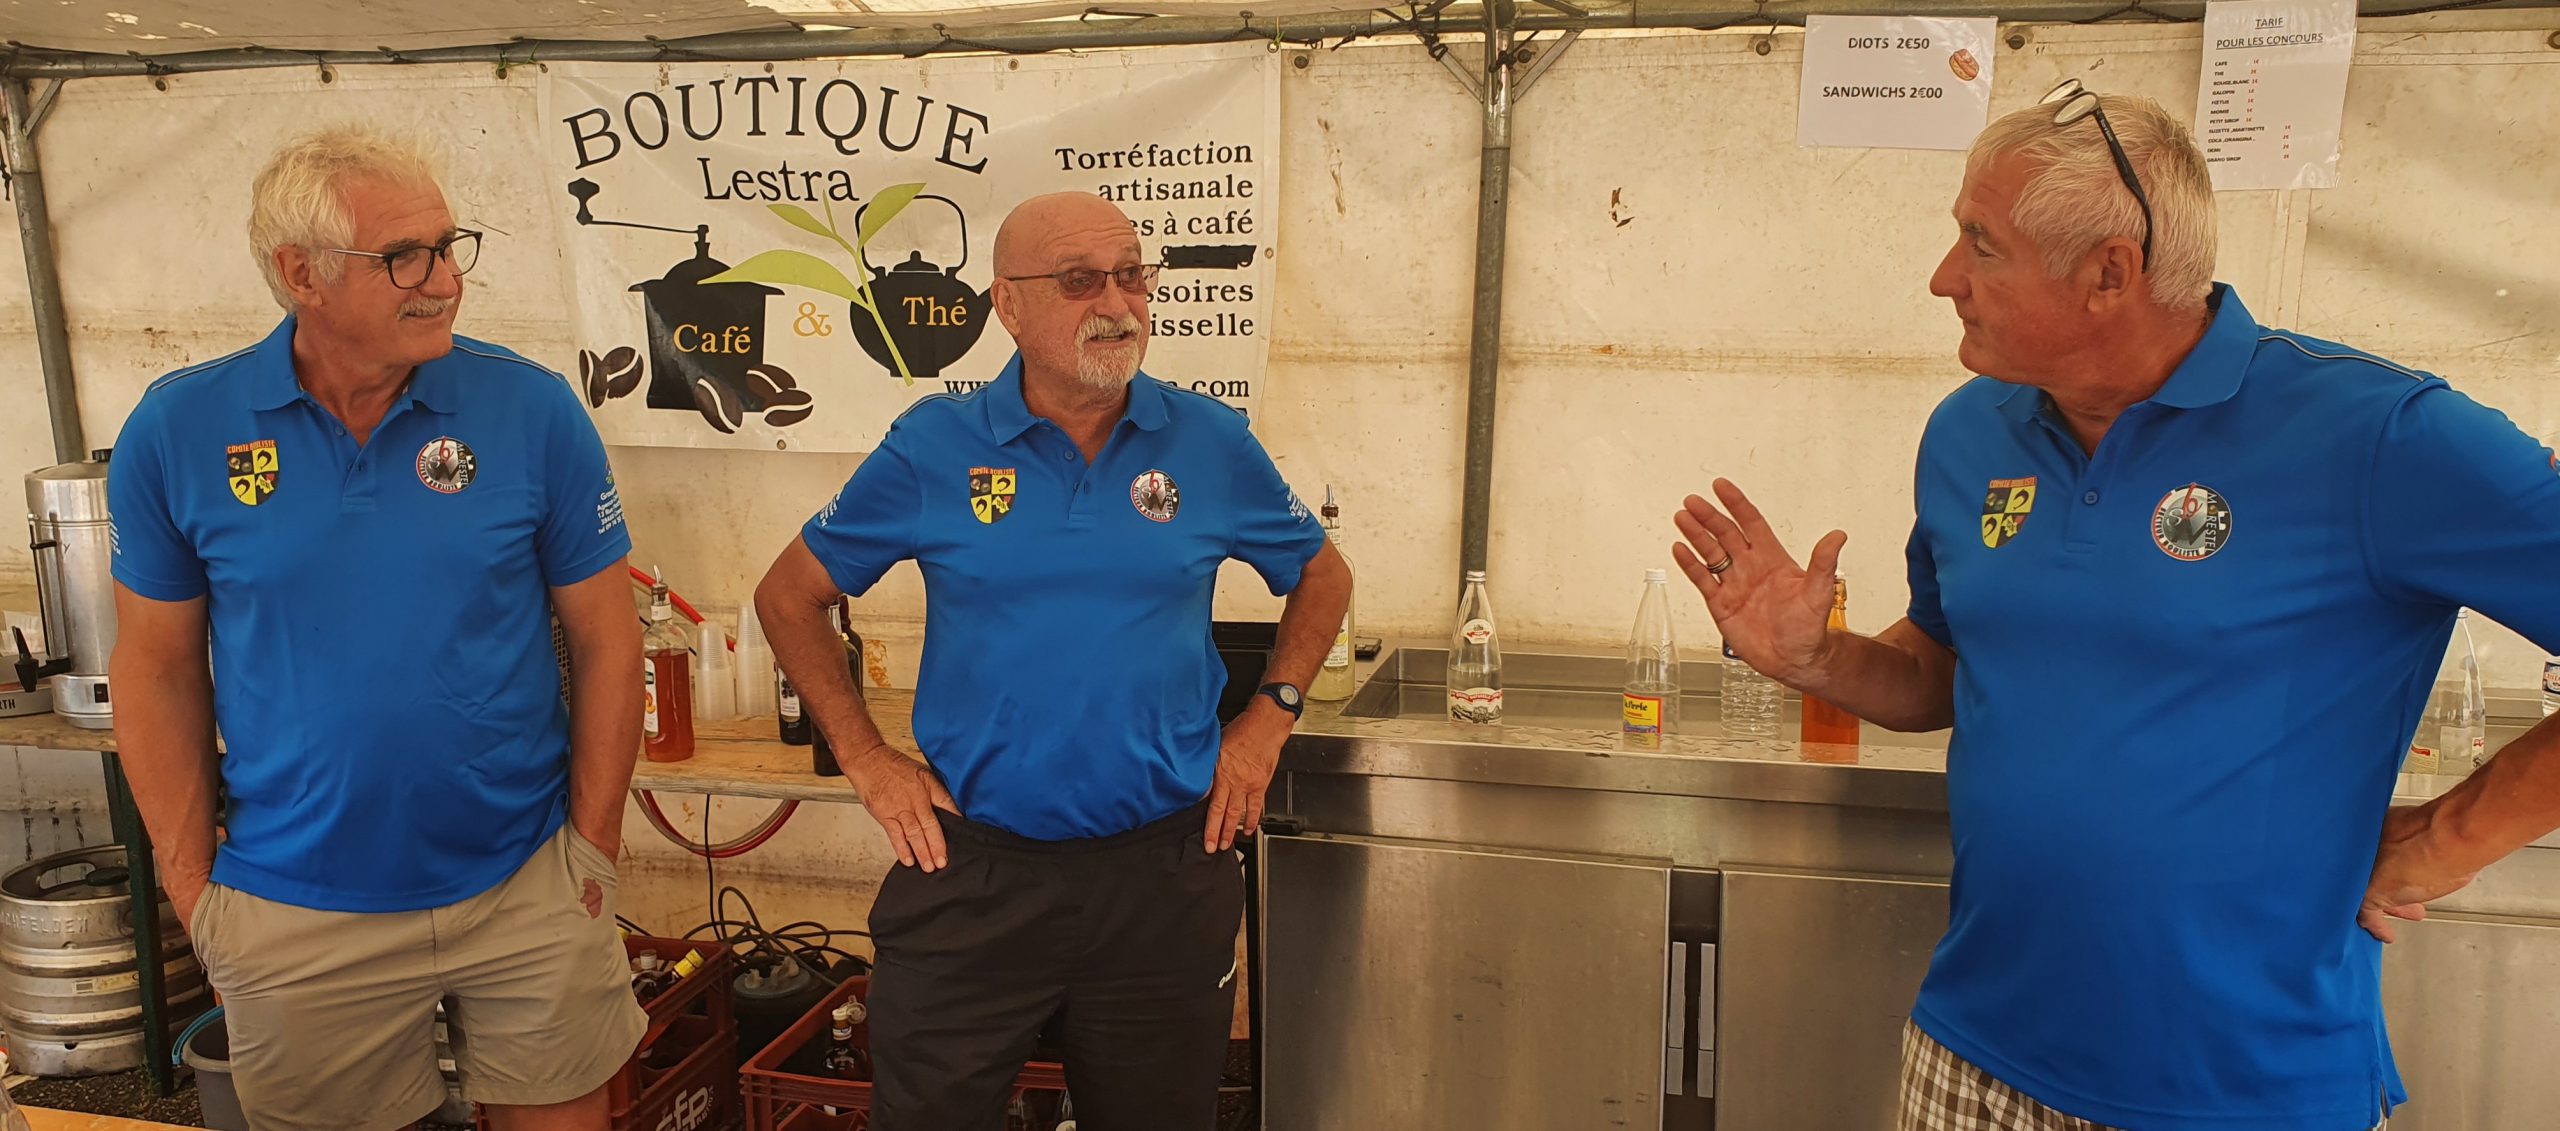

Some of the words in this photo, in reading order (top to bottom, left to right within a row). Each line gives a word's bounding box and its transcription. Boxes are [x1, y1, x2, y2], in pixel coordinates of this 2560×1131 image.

[2255, 17, 2284, 29] TARIF
[1848, 37, 1889, 49] DIOTS
[1896, 37, 1930, 49] 2€50
[2216, 39, 2245, 49] POUR
[2247, 37, 2264, 47] LES
[2266, 33, 2324, 46] CONCOURS
[1822, 86, 1905, 98] SANDWICHS
[1909, 87, 1943, 99] 2€00
[562, 75, 989, 175] BOUTIQUE
[1055, 140, 1254, 171] Torréfaction
[697, 157, 860, 203] Lestra
[1098, 173, 1254, 202] artisanale
[1162, 211, 1178, 236] à
[1187, 208, 1254, 236] café
[792, 301, 834, 338] &
[902, 295, 968, 327] Thé
[1149, 313, 1255, 337] isselle
[672, 323, 752, 355] Café
